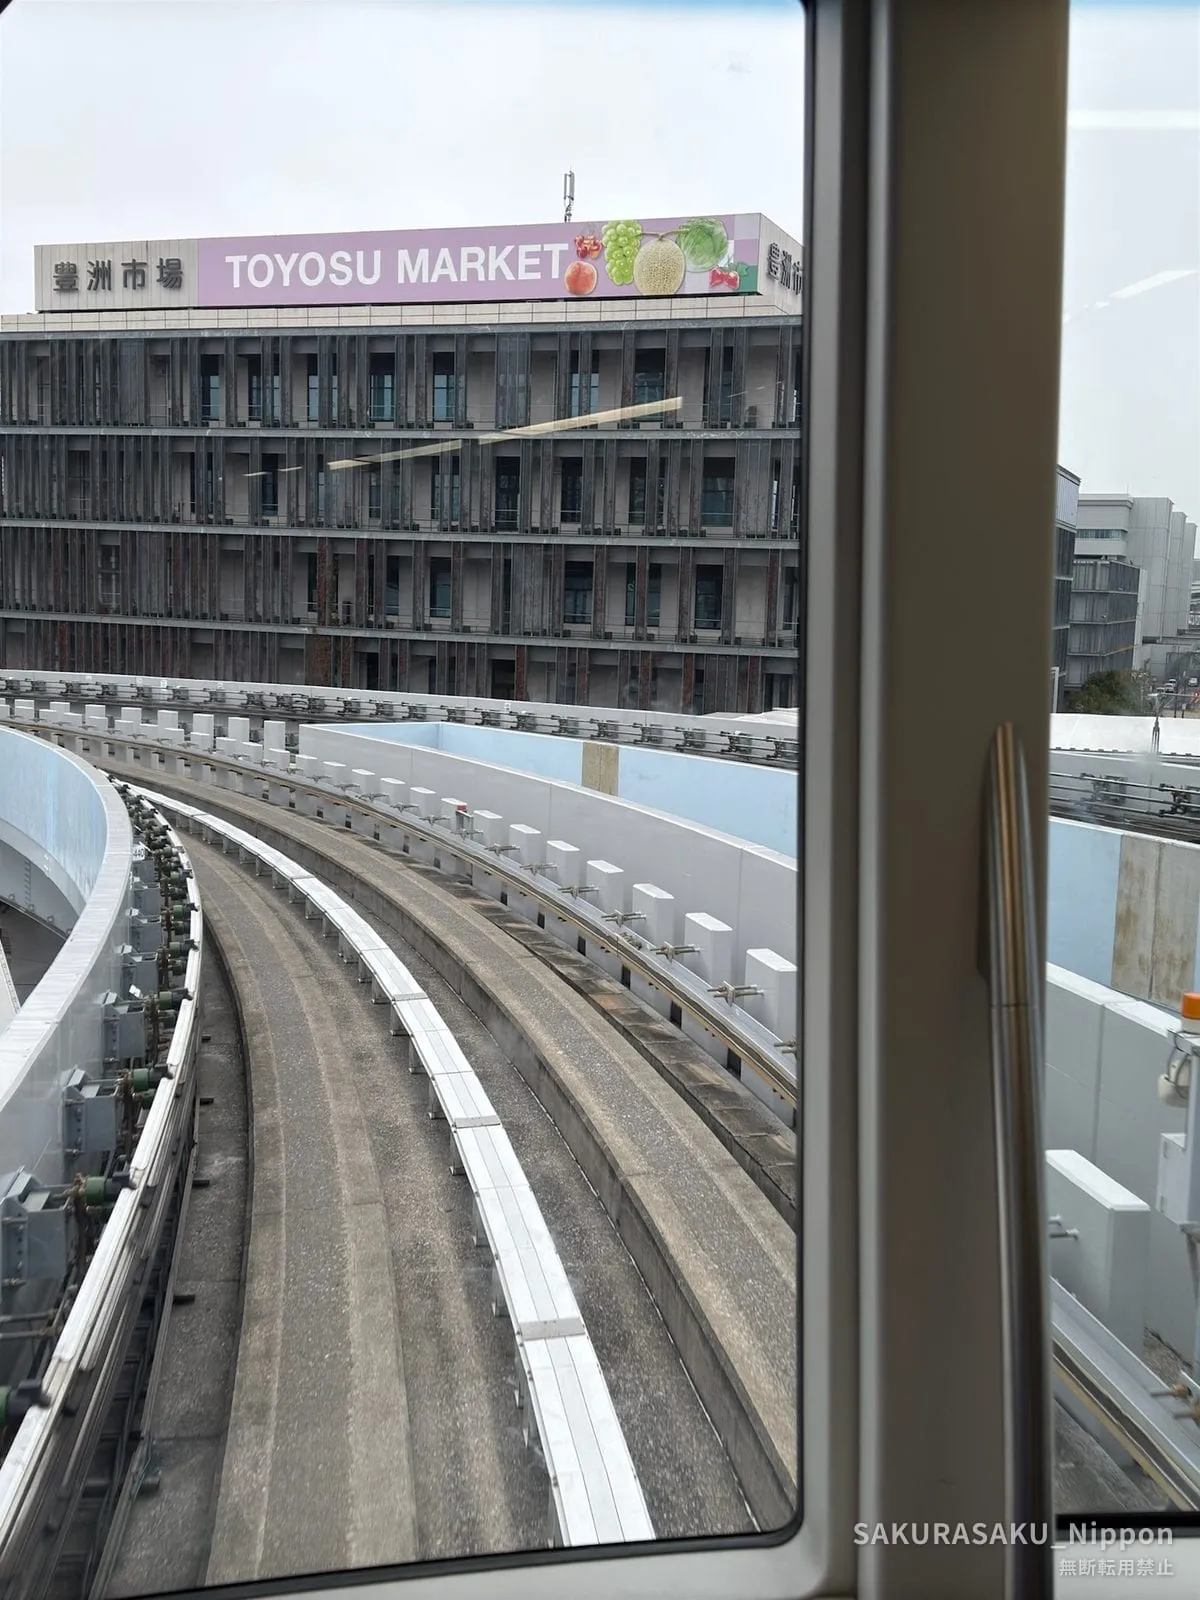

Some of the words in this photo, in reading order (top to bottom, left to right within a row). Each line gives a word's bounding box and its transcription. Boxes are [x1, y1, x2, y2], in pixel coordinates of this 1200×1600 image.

[53, 257, 184, 292] 豊洲市場
[225, 250, 381, 289] TOYOSU
[397, 243, 569, 285] MARKET
